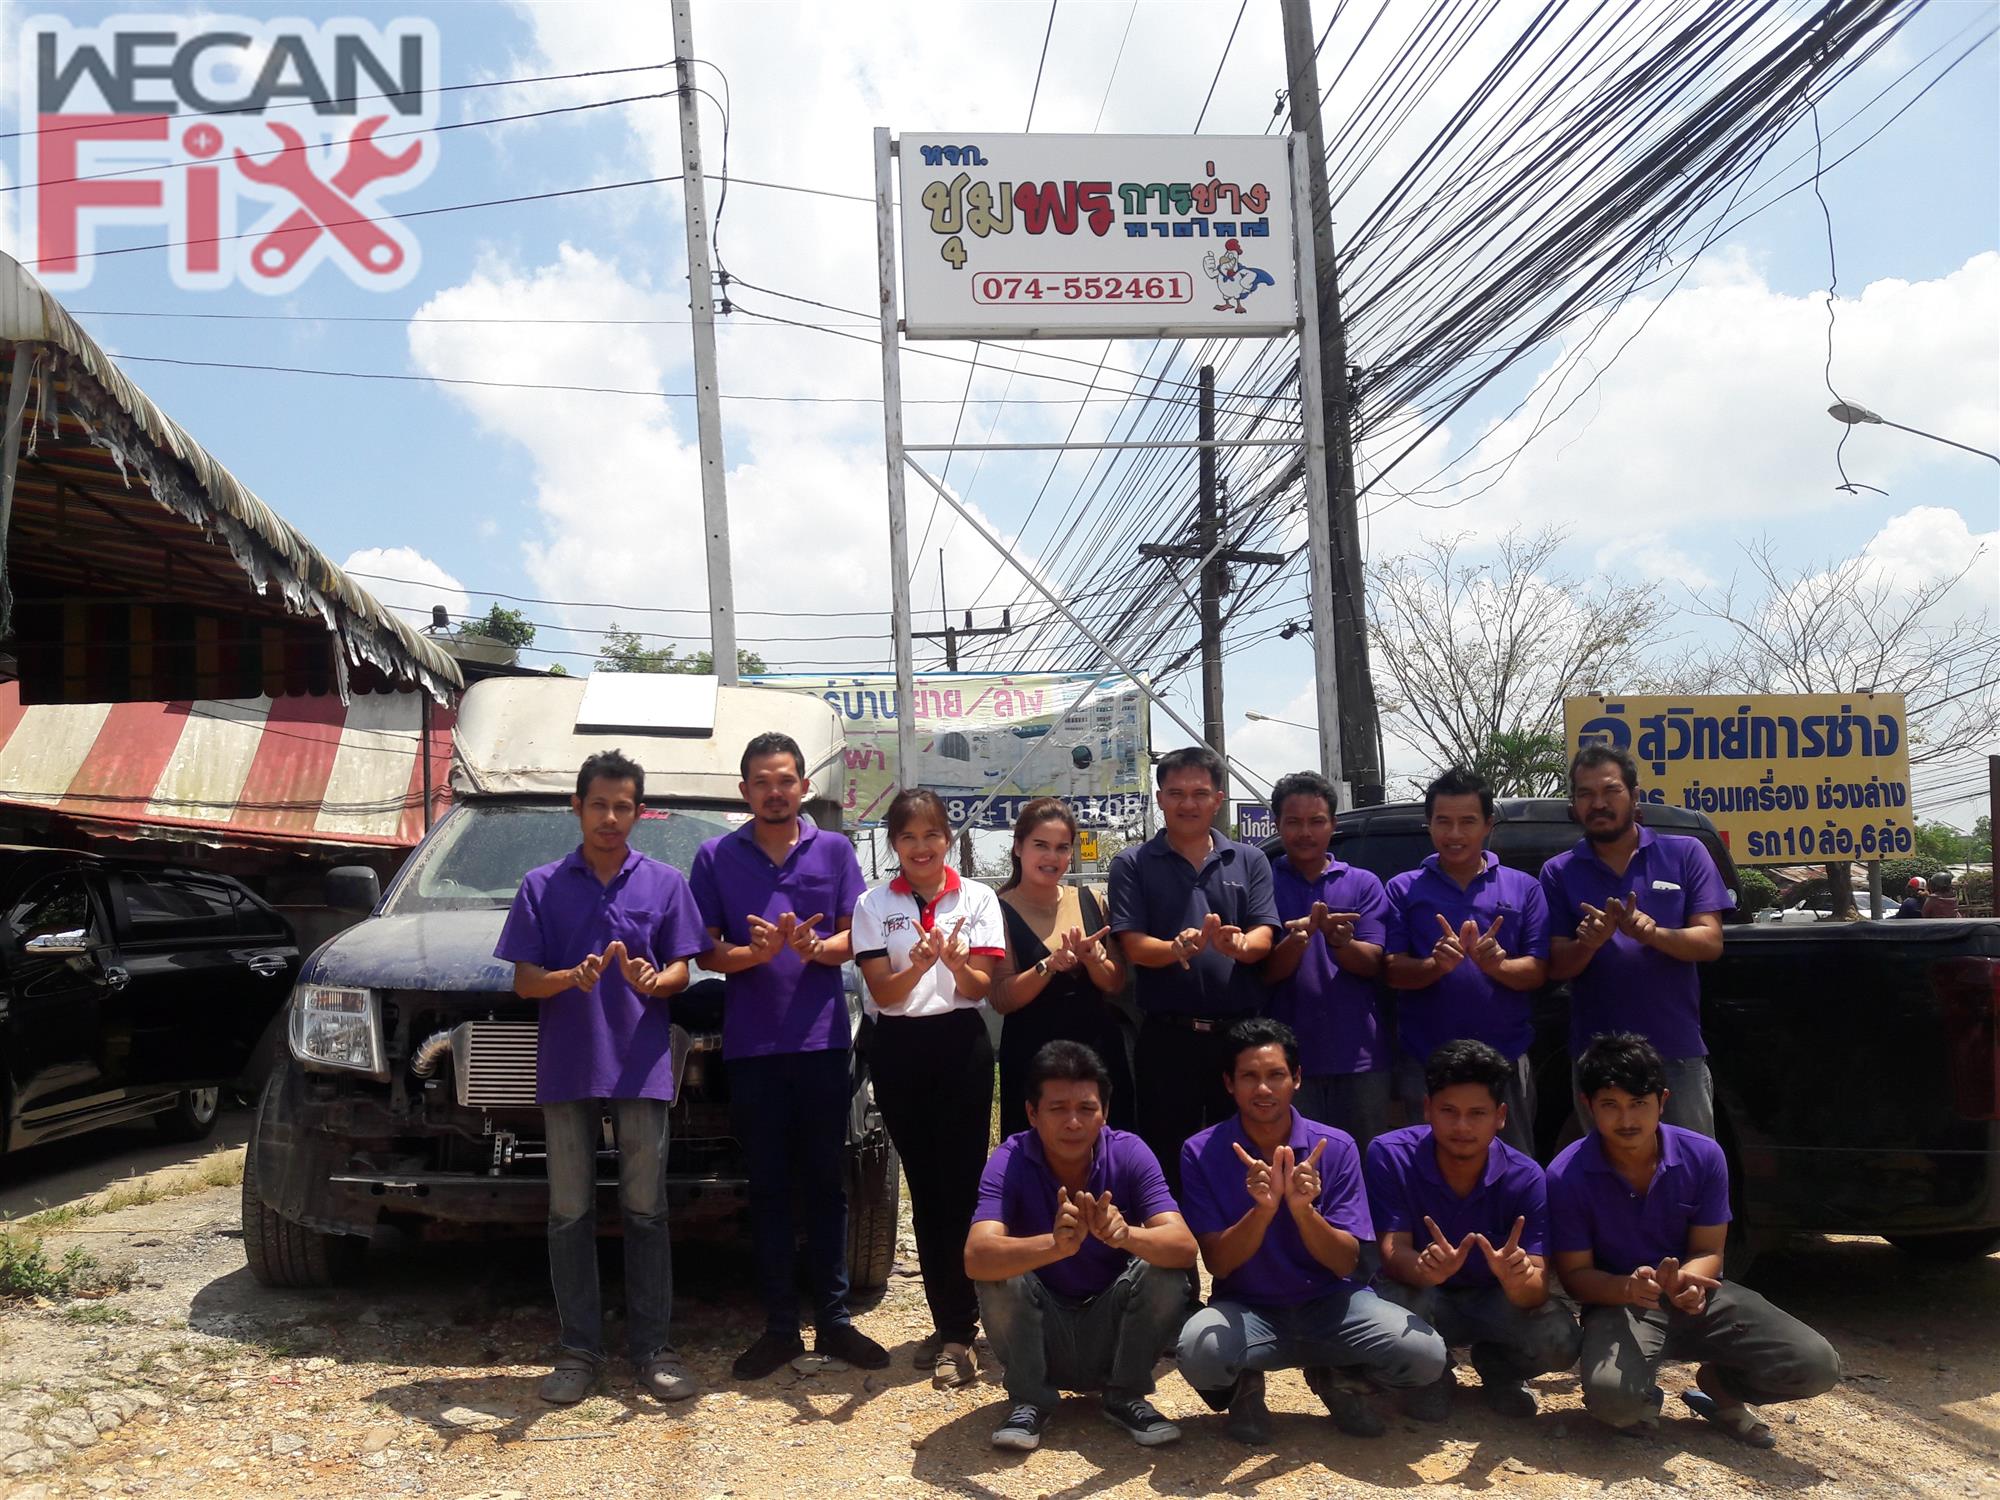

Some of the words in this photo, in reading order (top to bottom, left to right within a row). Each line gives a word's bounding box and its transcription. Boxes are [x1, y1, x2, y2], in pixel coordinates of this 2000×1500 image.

[920, 145, 989, 166] หจก.
[983, 276, 1183, 299] 074-552461
[1816, 776, 1906, 810] ช่วงล่าง
